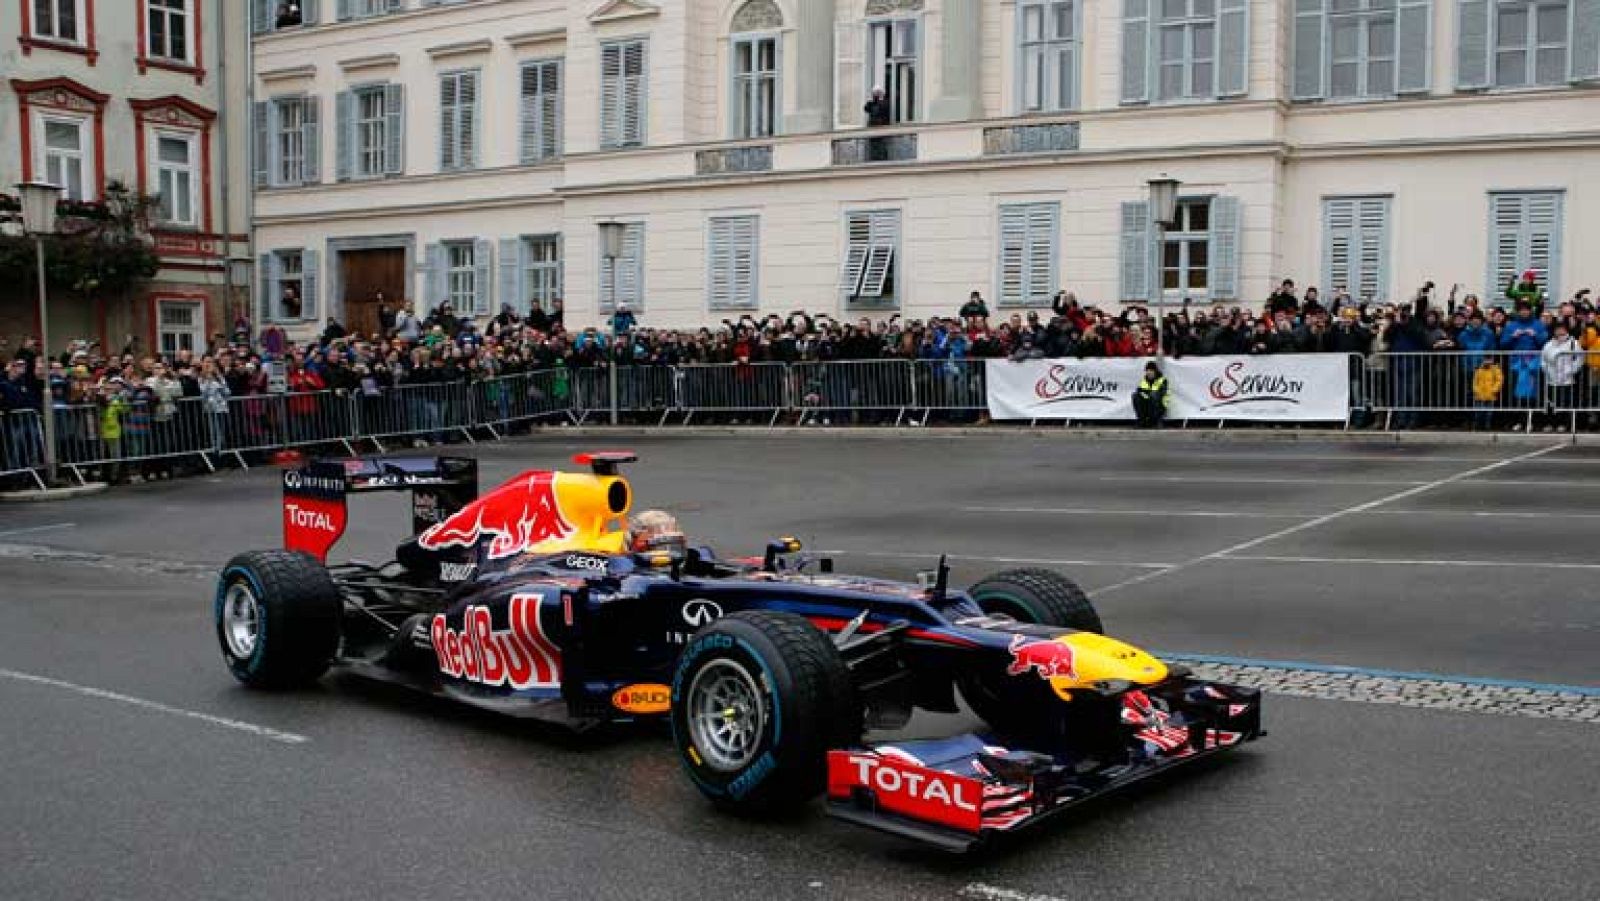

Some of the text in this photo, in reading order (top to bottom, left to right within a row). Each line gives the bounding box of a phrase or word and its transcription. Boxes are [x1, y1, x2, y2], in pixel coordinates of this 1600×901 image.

[285, 505, 336, 532] TOTAL
[567, 555, 608, 576] GEOX
[849, 756, 977, 812] TOTAL
